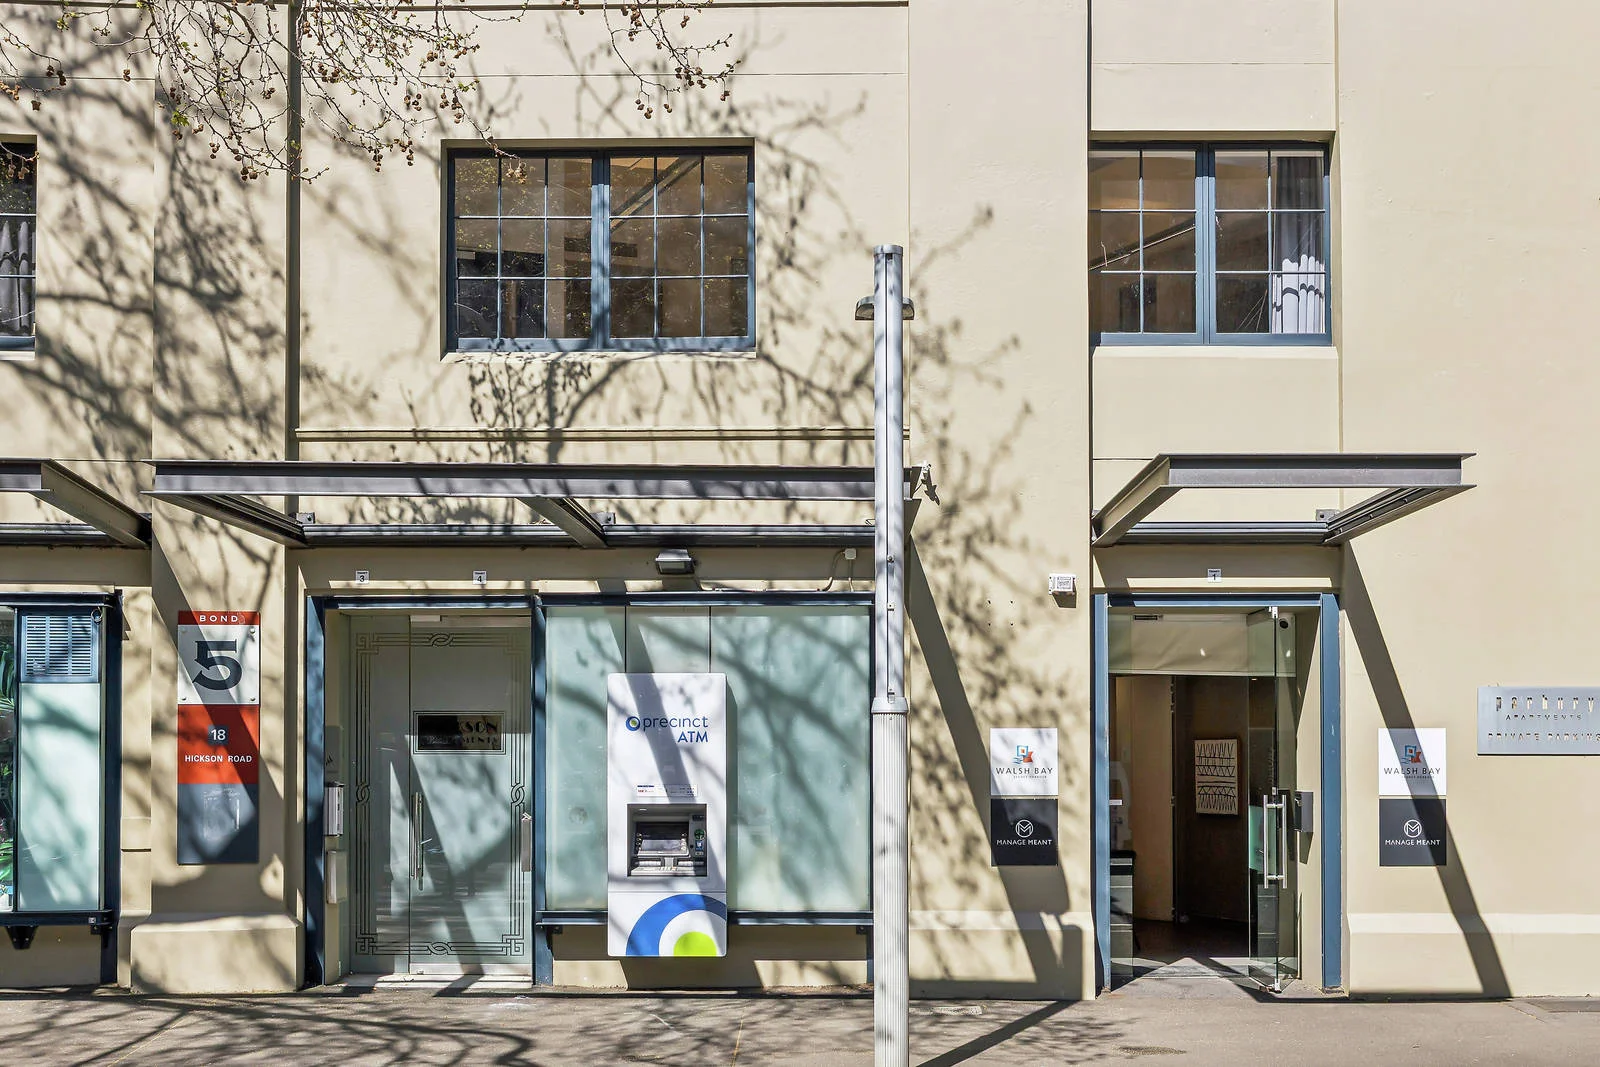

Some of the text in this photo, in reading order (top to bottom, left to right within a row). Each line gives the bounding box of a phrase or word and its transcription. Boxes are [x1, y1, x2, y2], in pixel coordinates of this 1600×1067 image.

[192, 639, 242, 690] 5
[643, 716, 709, 732] precinct
[210, 728, 226, 741] 18
[677, 731, 709, 743] ATM
[184, 755, 253, 763] HICKSON ROAD
[995, 767, 1053, 775] WALSH BAY
[1383, 767, 1441, 775] WALSH BAY
